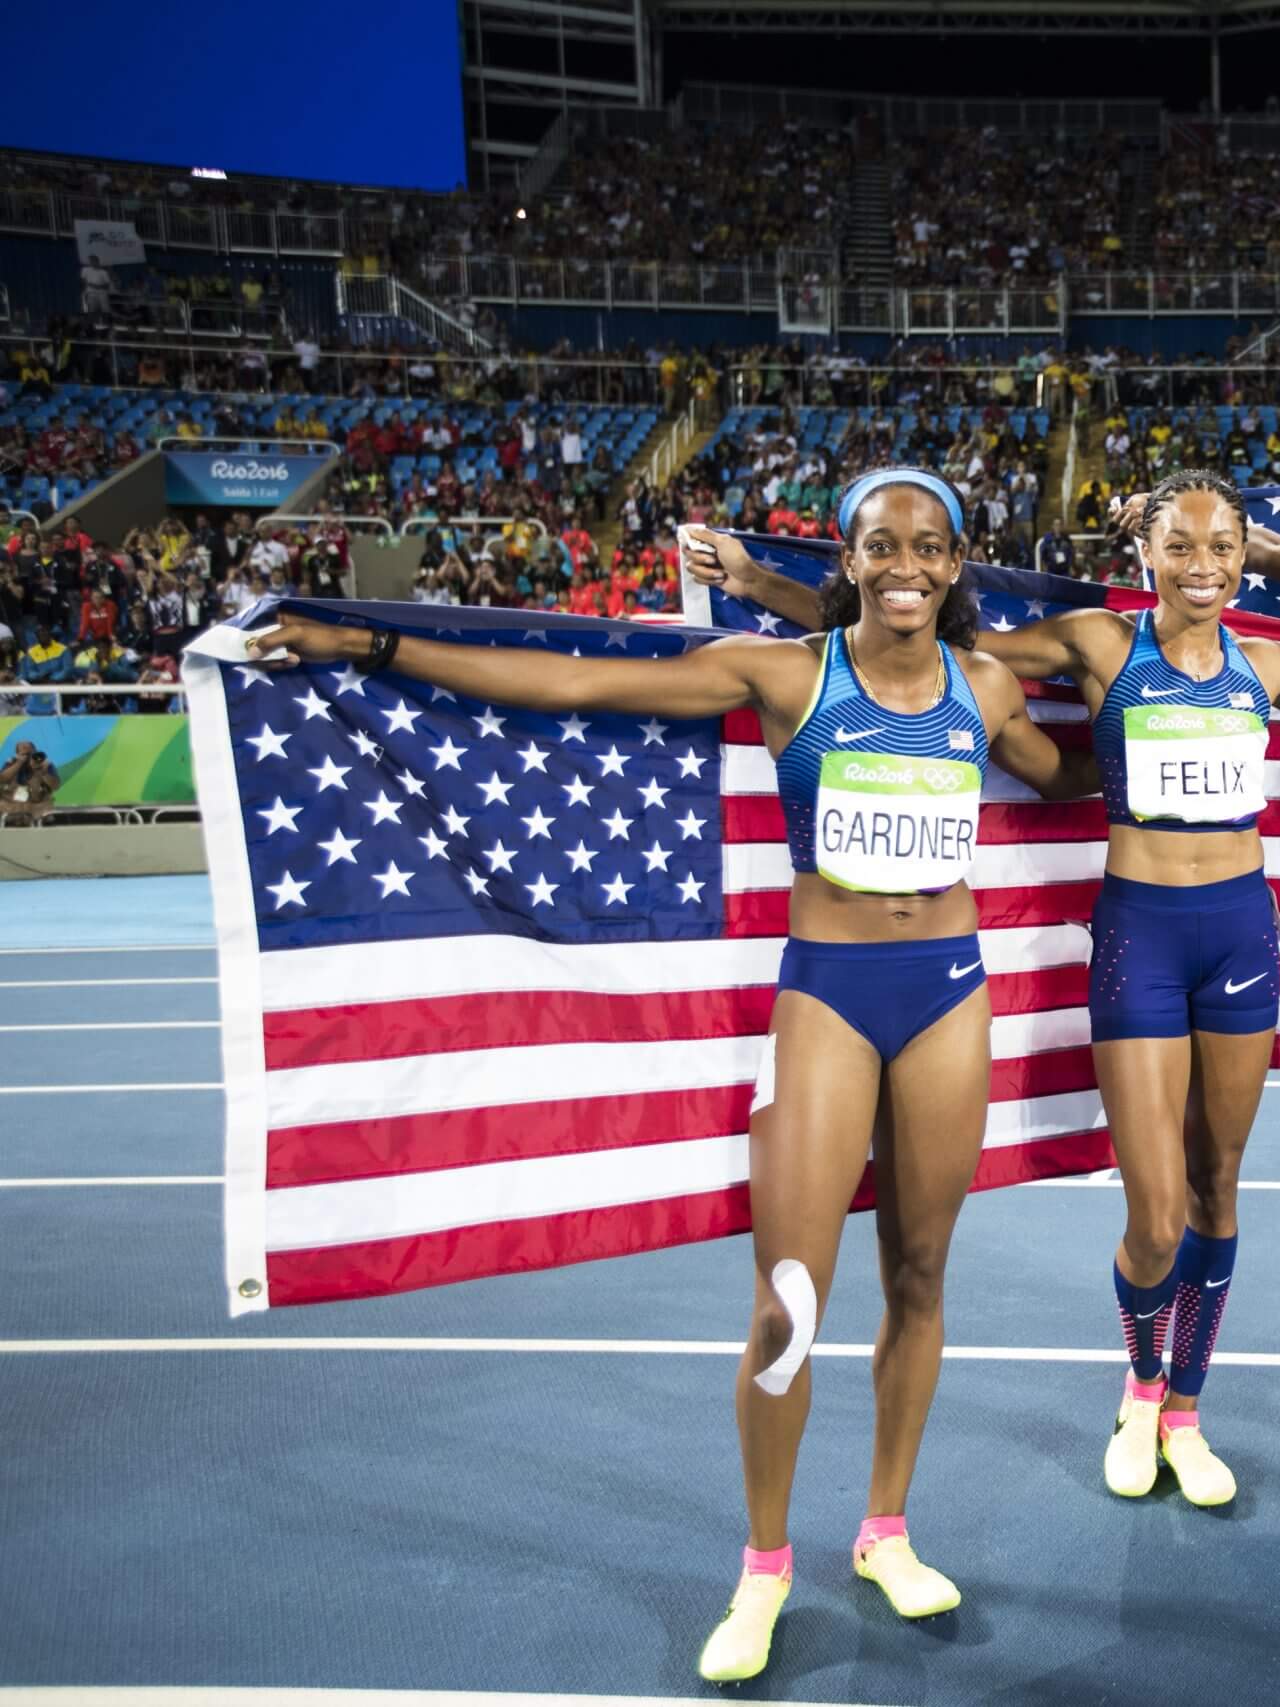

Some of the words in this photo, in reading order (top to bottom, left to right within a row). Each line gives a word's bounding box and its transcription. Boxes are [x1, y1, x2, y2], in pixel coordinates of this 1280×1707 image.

[211, 460, 289, 481] Rio2016
[1147, 714, 1206, 731] Rio2016
[844, 763, 914, 784] Rio2016
[1160, 761, 1245, 796] FELIX
[822, 809, 974, 861] GARDNER
